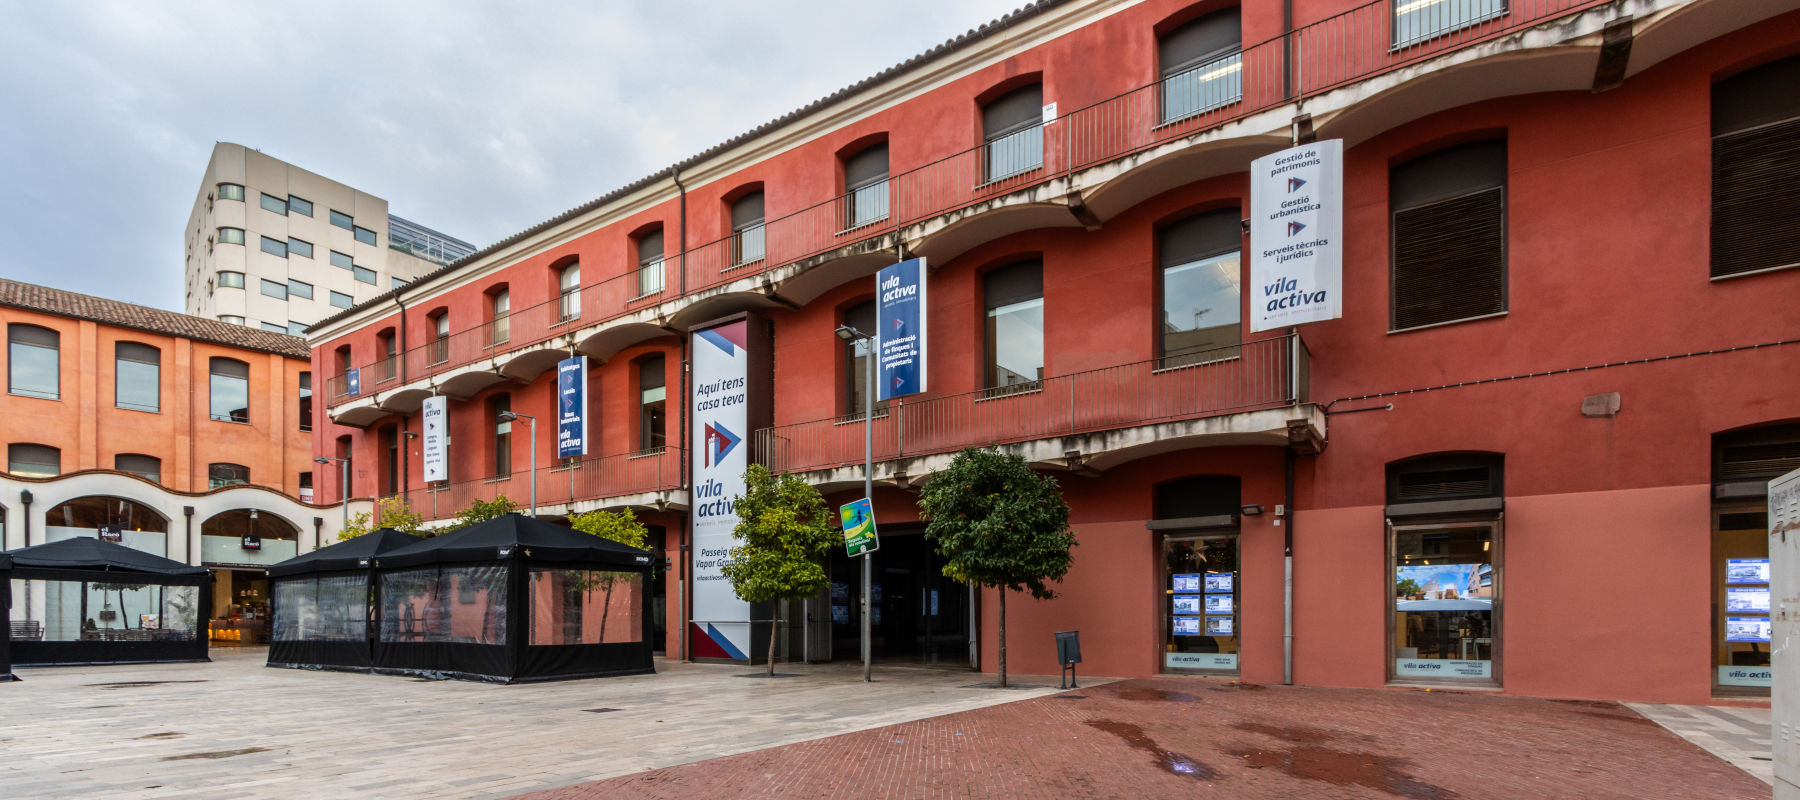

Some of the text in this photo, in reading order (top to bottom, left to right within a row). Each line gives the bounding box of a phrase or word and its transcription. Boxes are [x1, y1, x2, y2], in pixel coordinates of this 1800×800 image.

[1275, 150, 1316, 166] Gestió de
[1271, 158, 1320, 177] patrimonis
[1270, 202, 1321, 220] urbanística
[1281, 196, 1309, 208] Gestió
[1263, 239, 1328, 258] Serveis tècnics
[1279, 250, 1313, 264] jurídics
[882, 275, 900, 291] vila
[1264, 276, 1298, 297] vila
[883, 284, 916, 302] activa
[1266, 290, 1327, 312] activa
[883, 335, 916, 348] Administració
[697, 377, 744, 397] Aquí tens
[697, 393, 745, 412] casa teva
[560, 429, 570, 440] vila
[561, 438, 580, 448] activa
[696, 478, 723, 499] vila
[698, 496, 736, 518] activ
[701, 547, 728, 558] Passeig
[695, 559, 715, 570] Vapor
